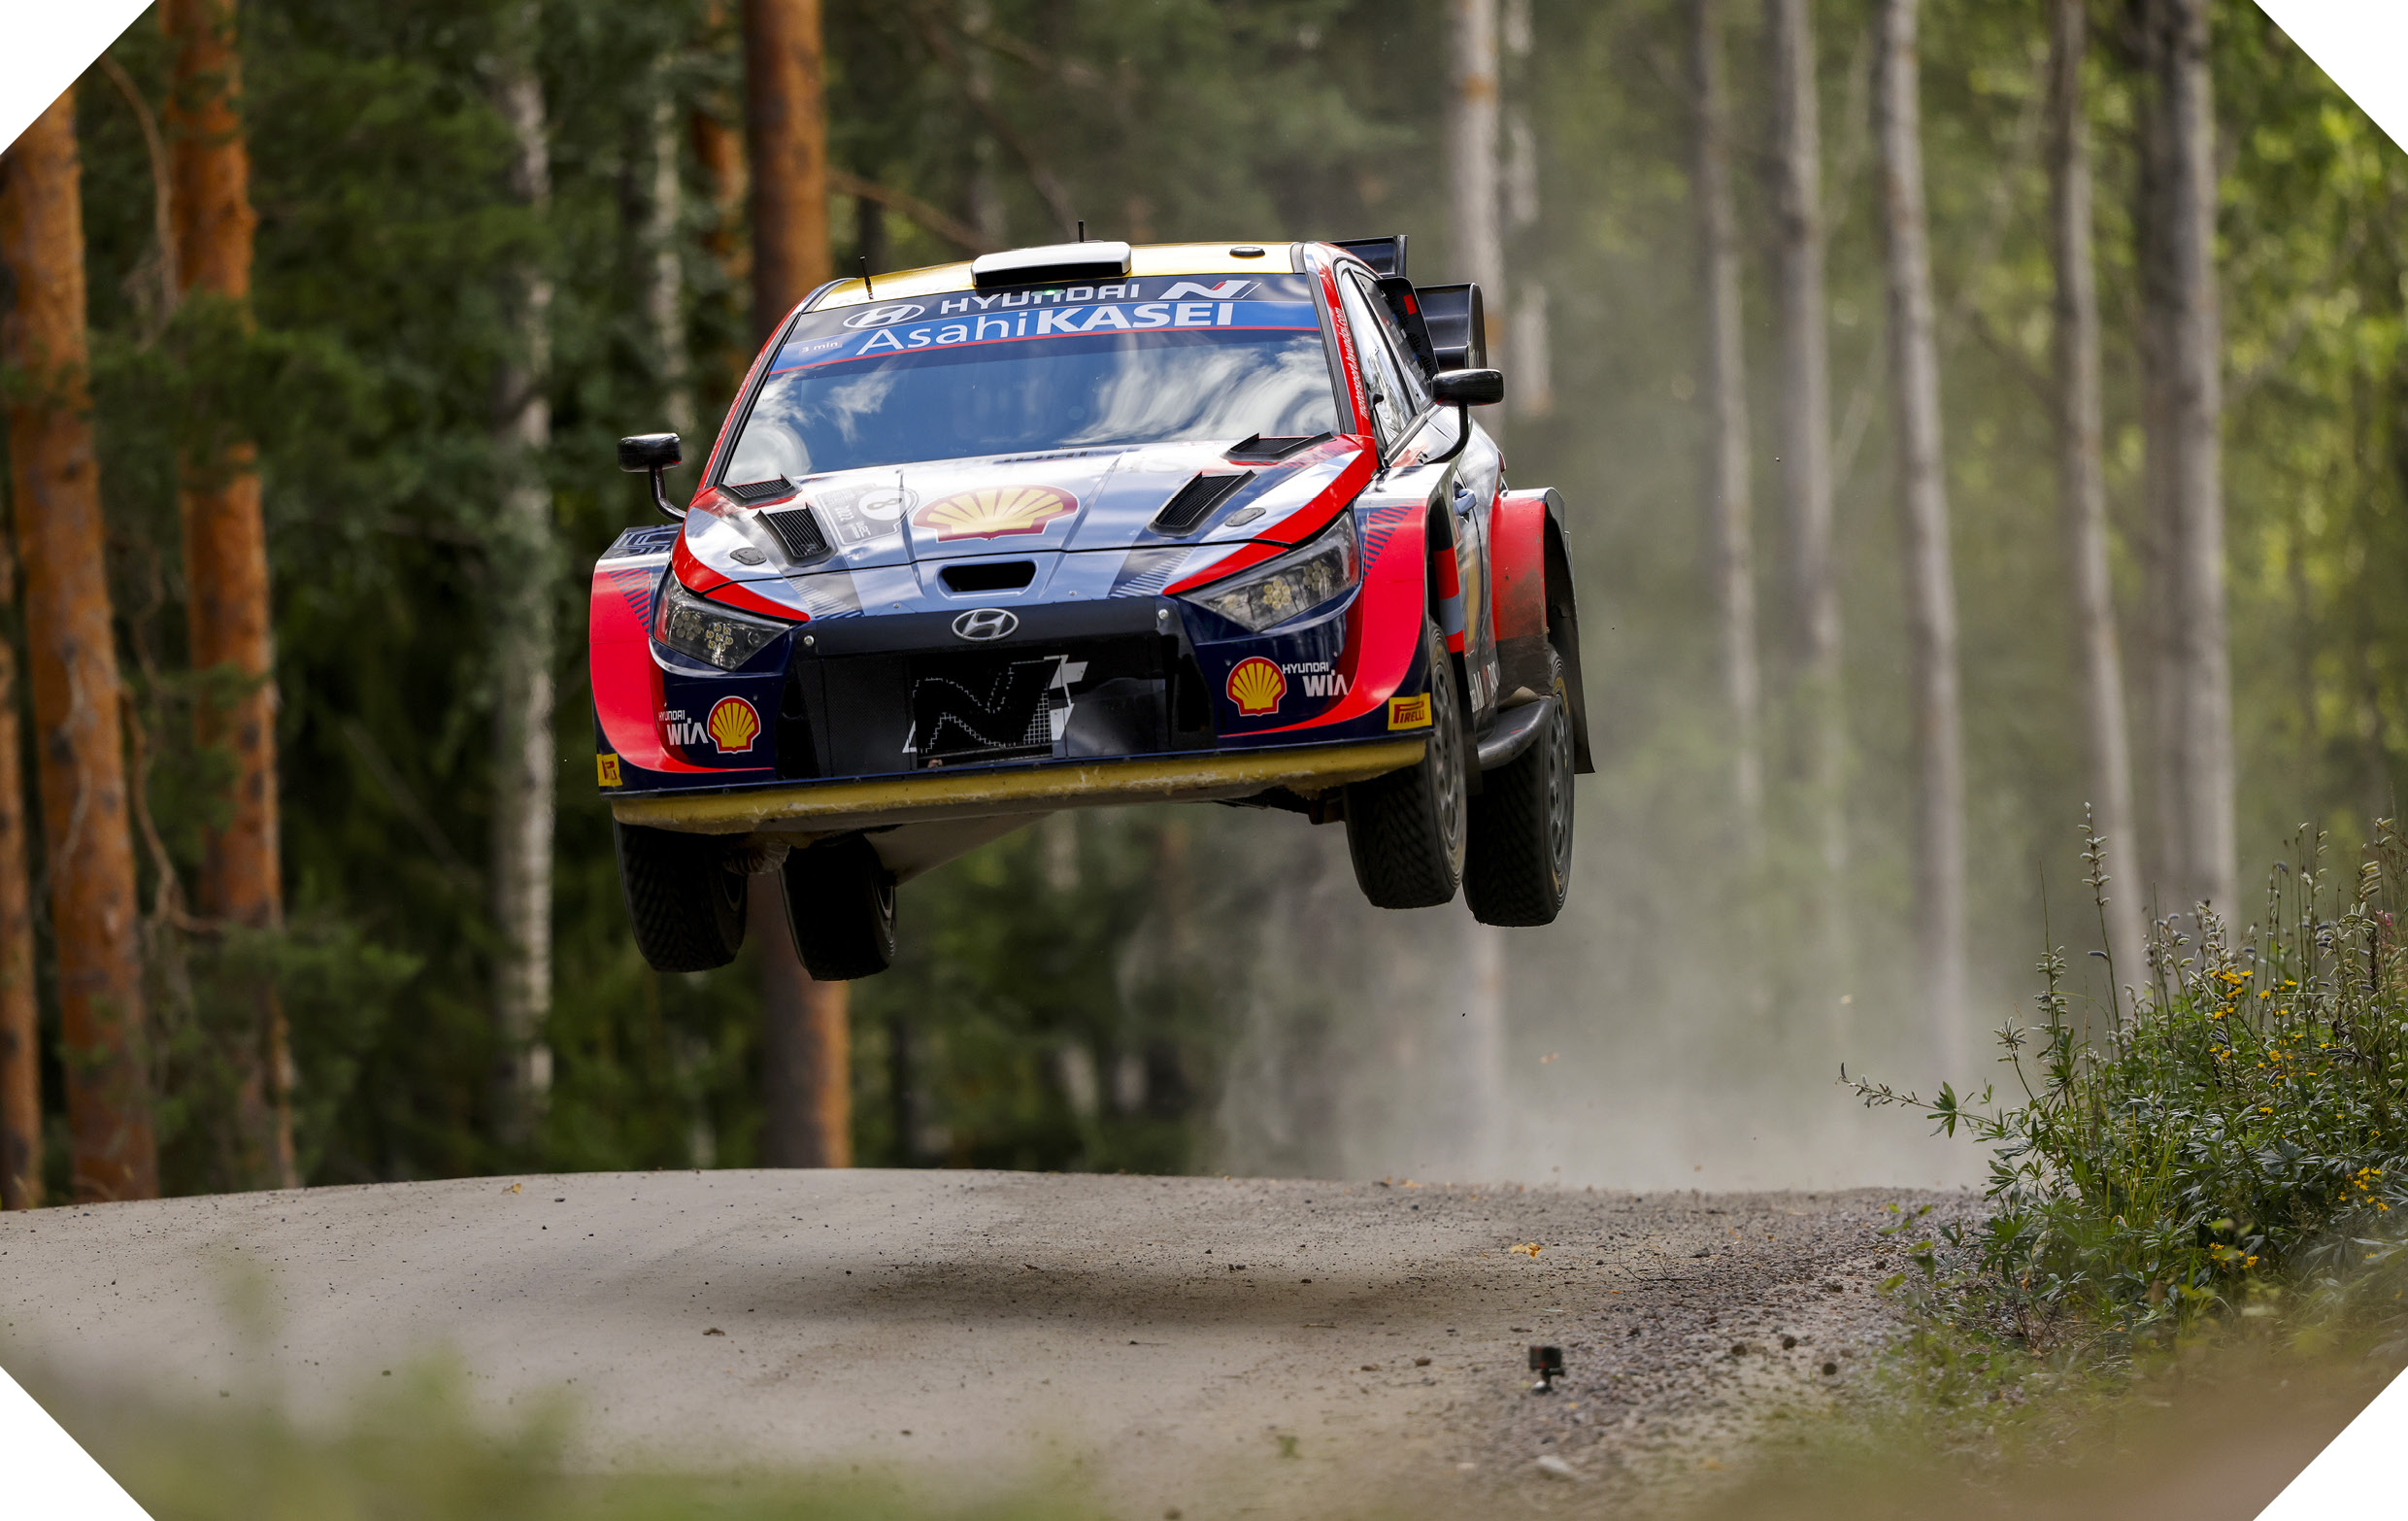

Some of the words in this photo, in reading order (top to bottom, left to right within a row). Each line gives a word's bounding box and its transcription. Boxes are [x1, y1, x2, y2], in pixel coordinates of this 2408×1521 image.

[940, 284, 1140, 314] HYUNDAI
[801, 344, 810, 354] 3
[813, 340, 838, 351] min
[1334, 306, 1368, 420] motorsport.hyundai.com
[1282, 661, 1329, 674] HYUNDAI
[658, 709, 686, 722] HYUNDAI
[1392, 700, 1425, 724] PIRELLI
